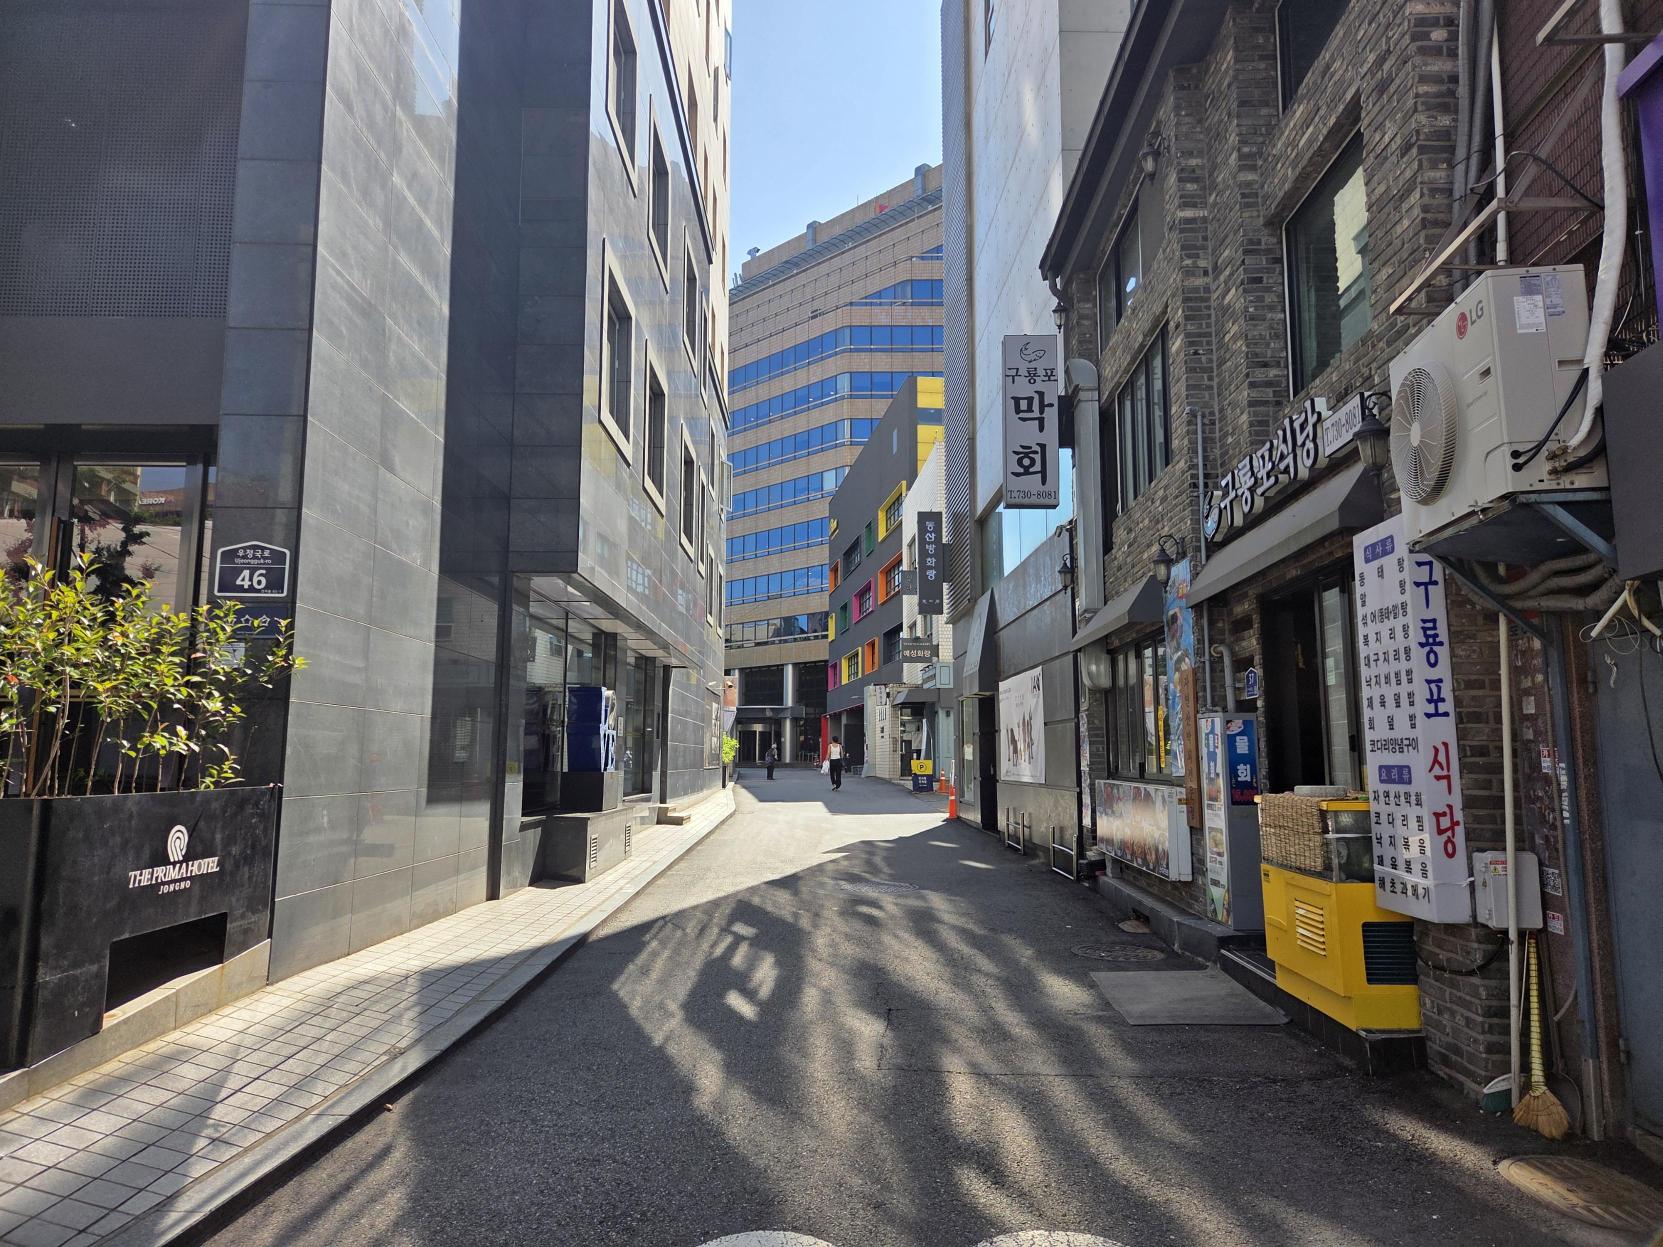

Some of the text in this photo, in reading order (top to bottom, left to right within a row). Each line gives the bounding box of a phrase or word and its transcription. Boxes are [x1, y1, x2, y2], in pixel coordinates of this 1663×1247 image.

[1469, 300, 1484, 324] LG
[1005, 366, 1058, 385] 구룡포
[1010, 390, 1055, 487] 막회
[1220, 398, 1321, 522] 구룡포식당
[1007, 489, 1057, 500] T.730-8081
[236, 549, 271, 558] 우정국로
[925, 522, 936, 580] 동산방화랑
[1366, 538, 1393, 560] 식사류
[236, 570, 266, 589] 46
[1413, 559, 1450, 720] 구룡포
[1369, 736, 1420, 754] 코다리양념구이
[1380, 768, 1411, 783] 요리류
[1372, 790, 1424, 809] 자연산막회
[1428, 741, 1461, 859] 식당
[129, 857, 220, 888] THE PRIMA HOTEL
[158, 880, 191, 894] JONGNO
